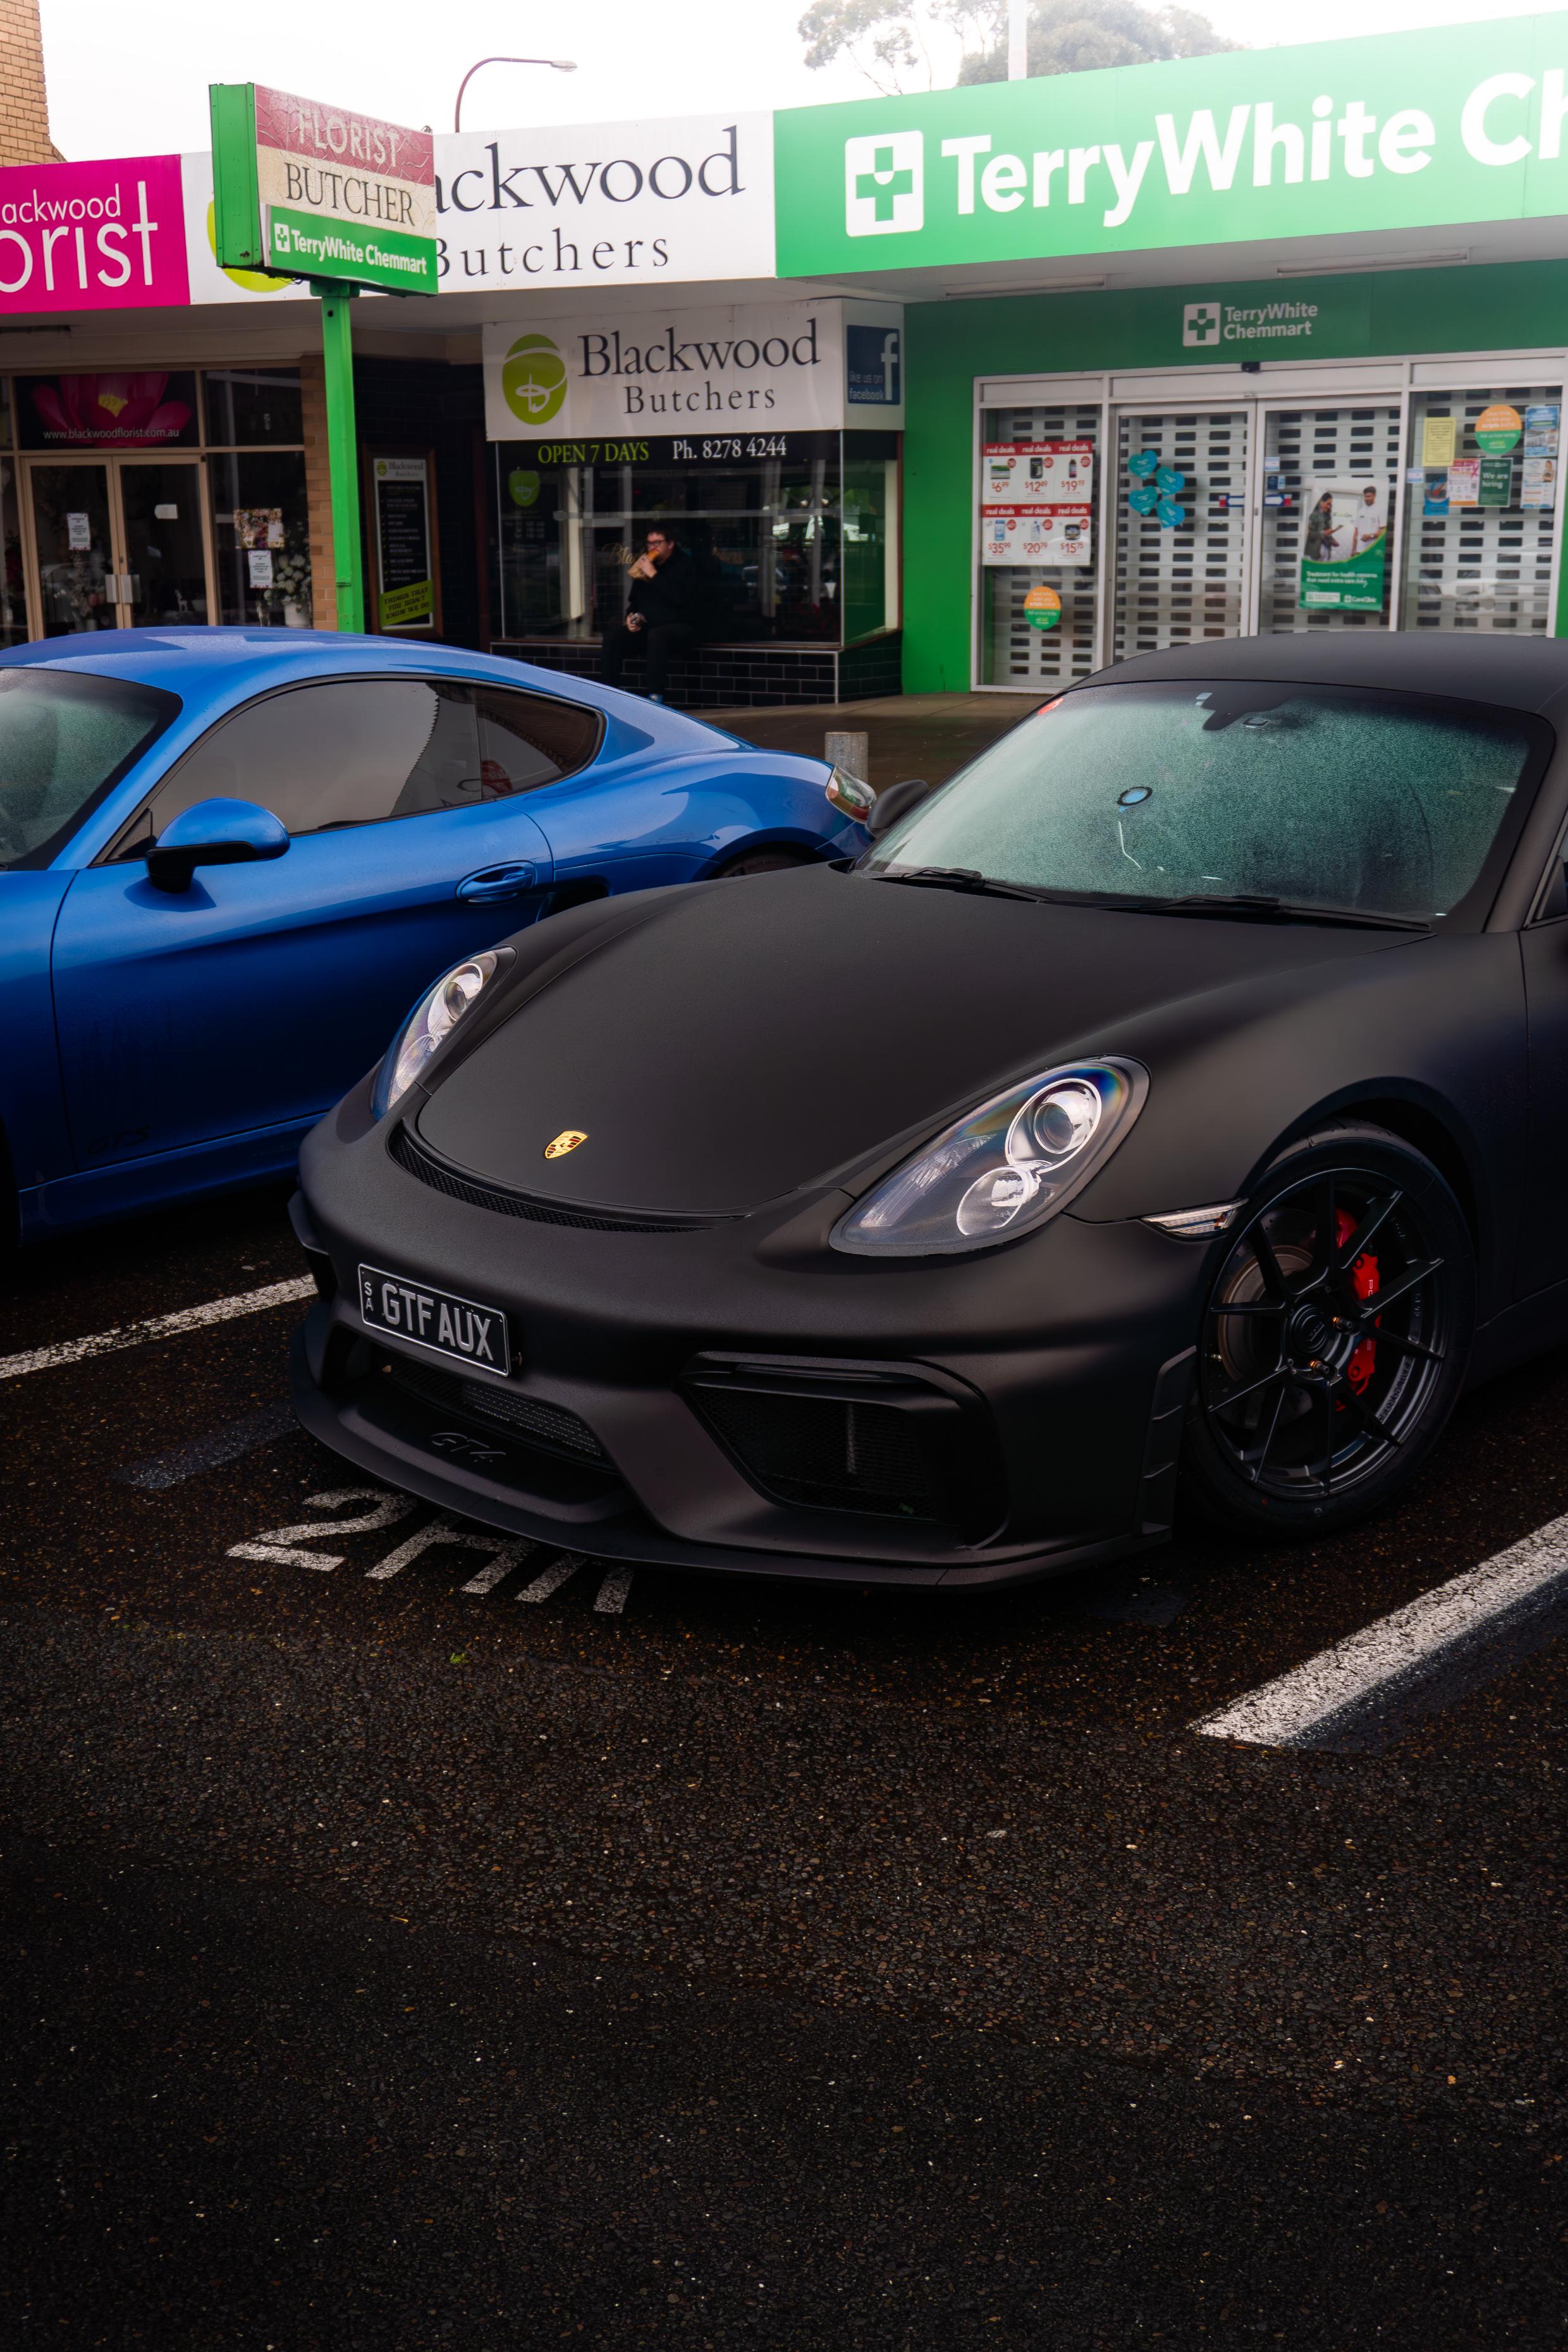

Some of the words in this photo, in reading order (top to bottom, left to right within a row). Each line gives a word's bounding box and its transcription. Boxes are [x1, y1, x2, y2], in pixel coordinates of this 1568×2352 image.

[297, 107, 400, 167] FLORIST
[435, 125, 746, 214] ckwood
[942, 95, 1435, 228] TerryWhite
[1, 182, 121, 224] ackwood
[284, 162, 415, 226] BUTCHER
[0, 181, 158, 293] orist
[291, 229, 364, 262] TerryWhite
[365, 244, 427, 275] Chemmart
[1223, 321, 1312, 340] Chemmart
[1224, 302, 1318, 324] TerryWhite
[577, 318, 821, 377] Blackwood
[623, 381, 775, 414] Butchers
[849, 387, 884, 400] facebook
[43, 427, 180, 439] www.blackwoodflorist.com.au
[537, 444, 585, 464] OPEN
[591, 444, 600, 463] 7
[604, 441, 649, 462] DAYS
[672, 440, 697, 460] Ph.
[702, 439, 742, 460] 8278
[746, 436, 787, 457] 4244
[1482, 481, 1503, 489] hiring
